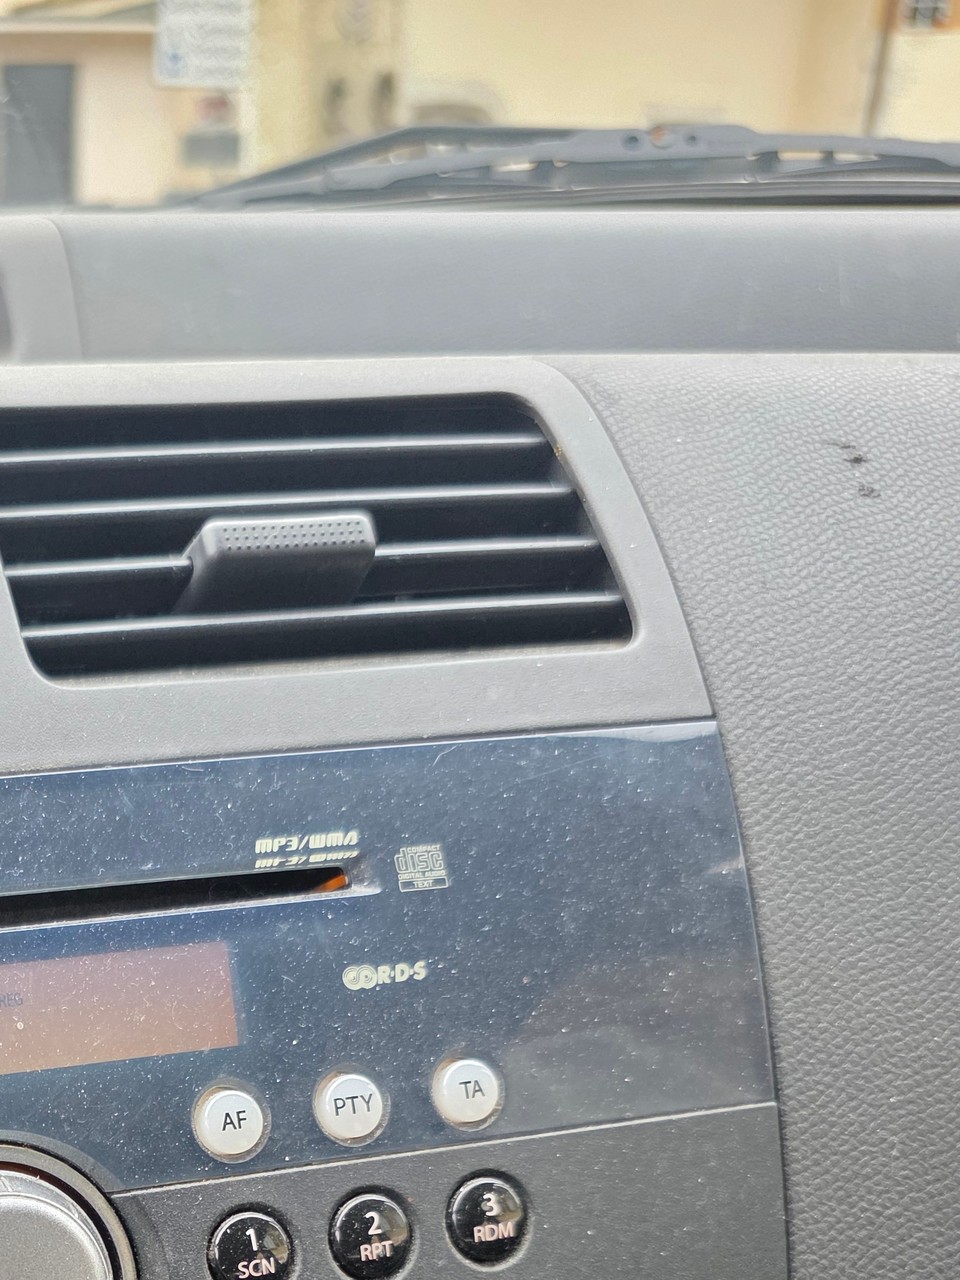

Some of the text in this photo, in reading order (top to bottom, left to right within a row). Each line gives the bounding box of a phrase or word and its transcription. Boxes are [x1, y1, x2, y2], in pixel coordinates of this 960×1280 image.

[255, 831, 359, 854] MP3/WMA
[413, 880, 434, 888] TEXT
[459, 1080, 485, 1100] TA
[334, 1093, 373, 1116] PTY
[221, 1111, 247, 1132] AF
[483, 1193, 499, 1216] 3
[365, 1212, 382, 1236] 2
[473, 1222, 514, 1243] RDM
[245, 1228, 259, 1252] 1
[360, 1240, 394, 1261] RPT
[238, 1257, 276, 1279] SCN
